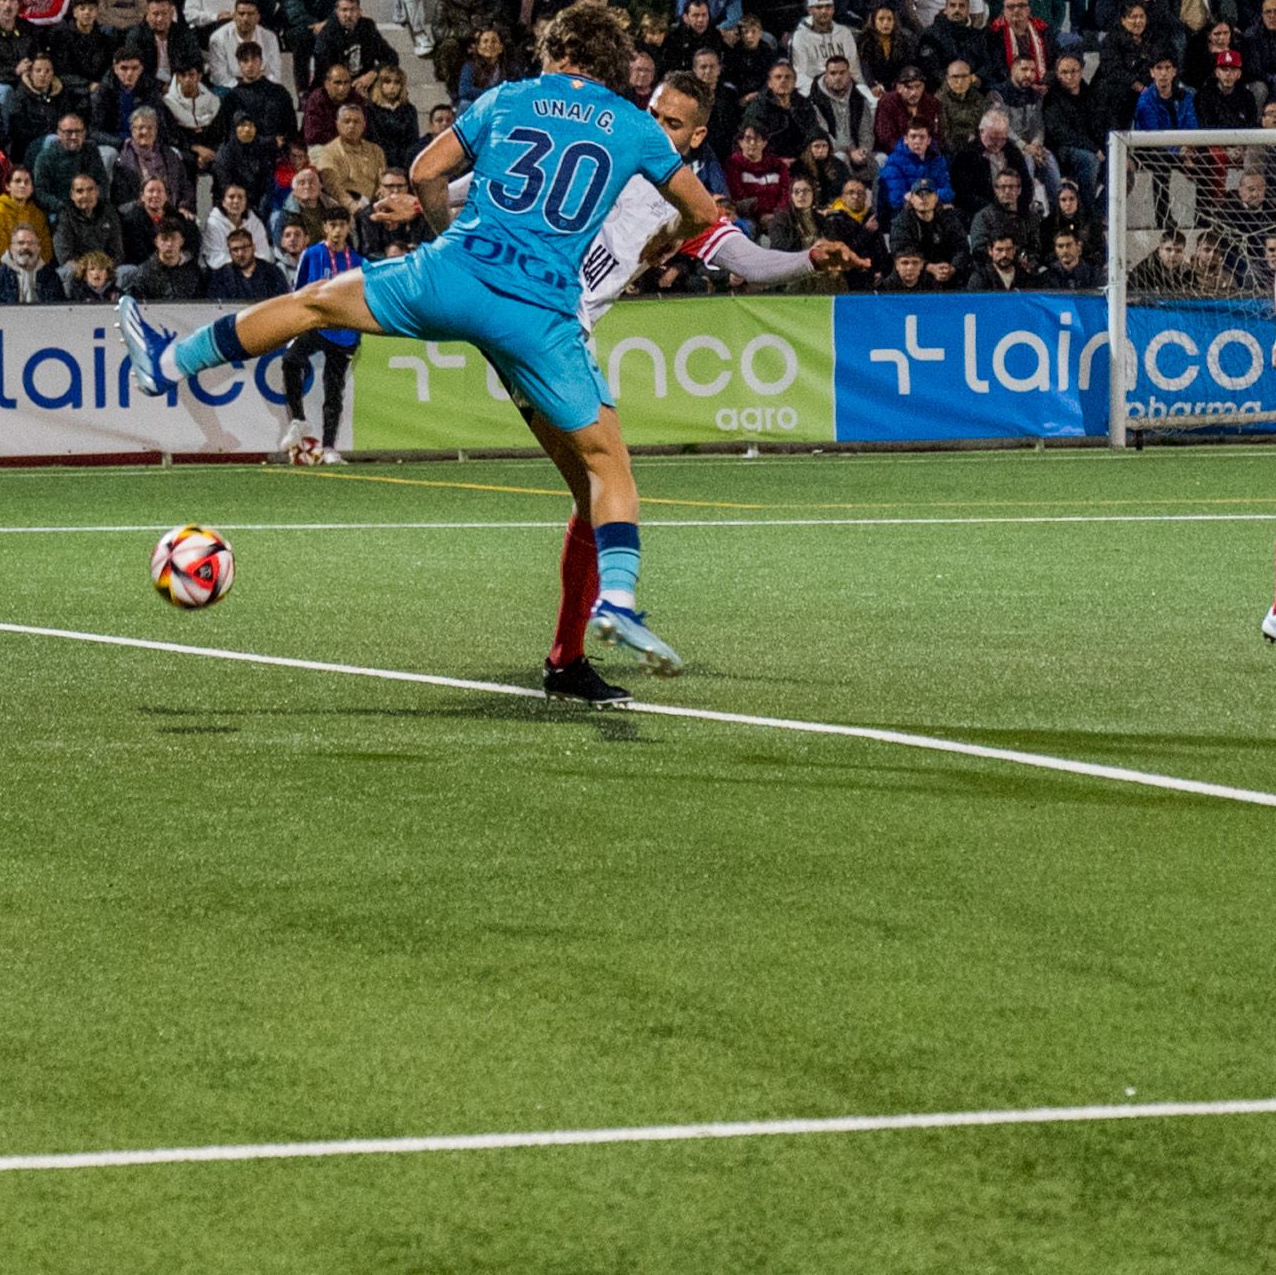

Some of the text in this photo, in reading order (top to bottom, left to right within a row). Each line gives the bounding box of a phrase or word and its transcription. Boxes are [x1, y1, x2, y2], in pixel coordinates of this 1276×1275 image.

[532, 98, 616, 135] UNAI G.
[487, 126, 613, 233] 30
[964, 311, 1265, 394] lainco
[715, 406, 798, 433] agro
